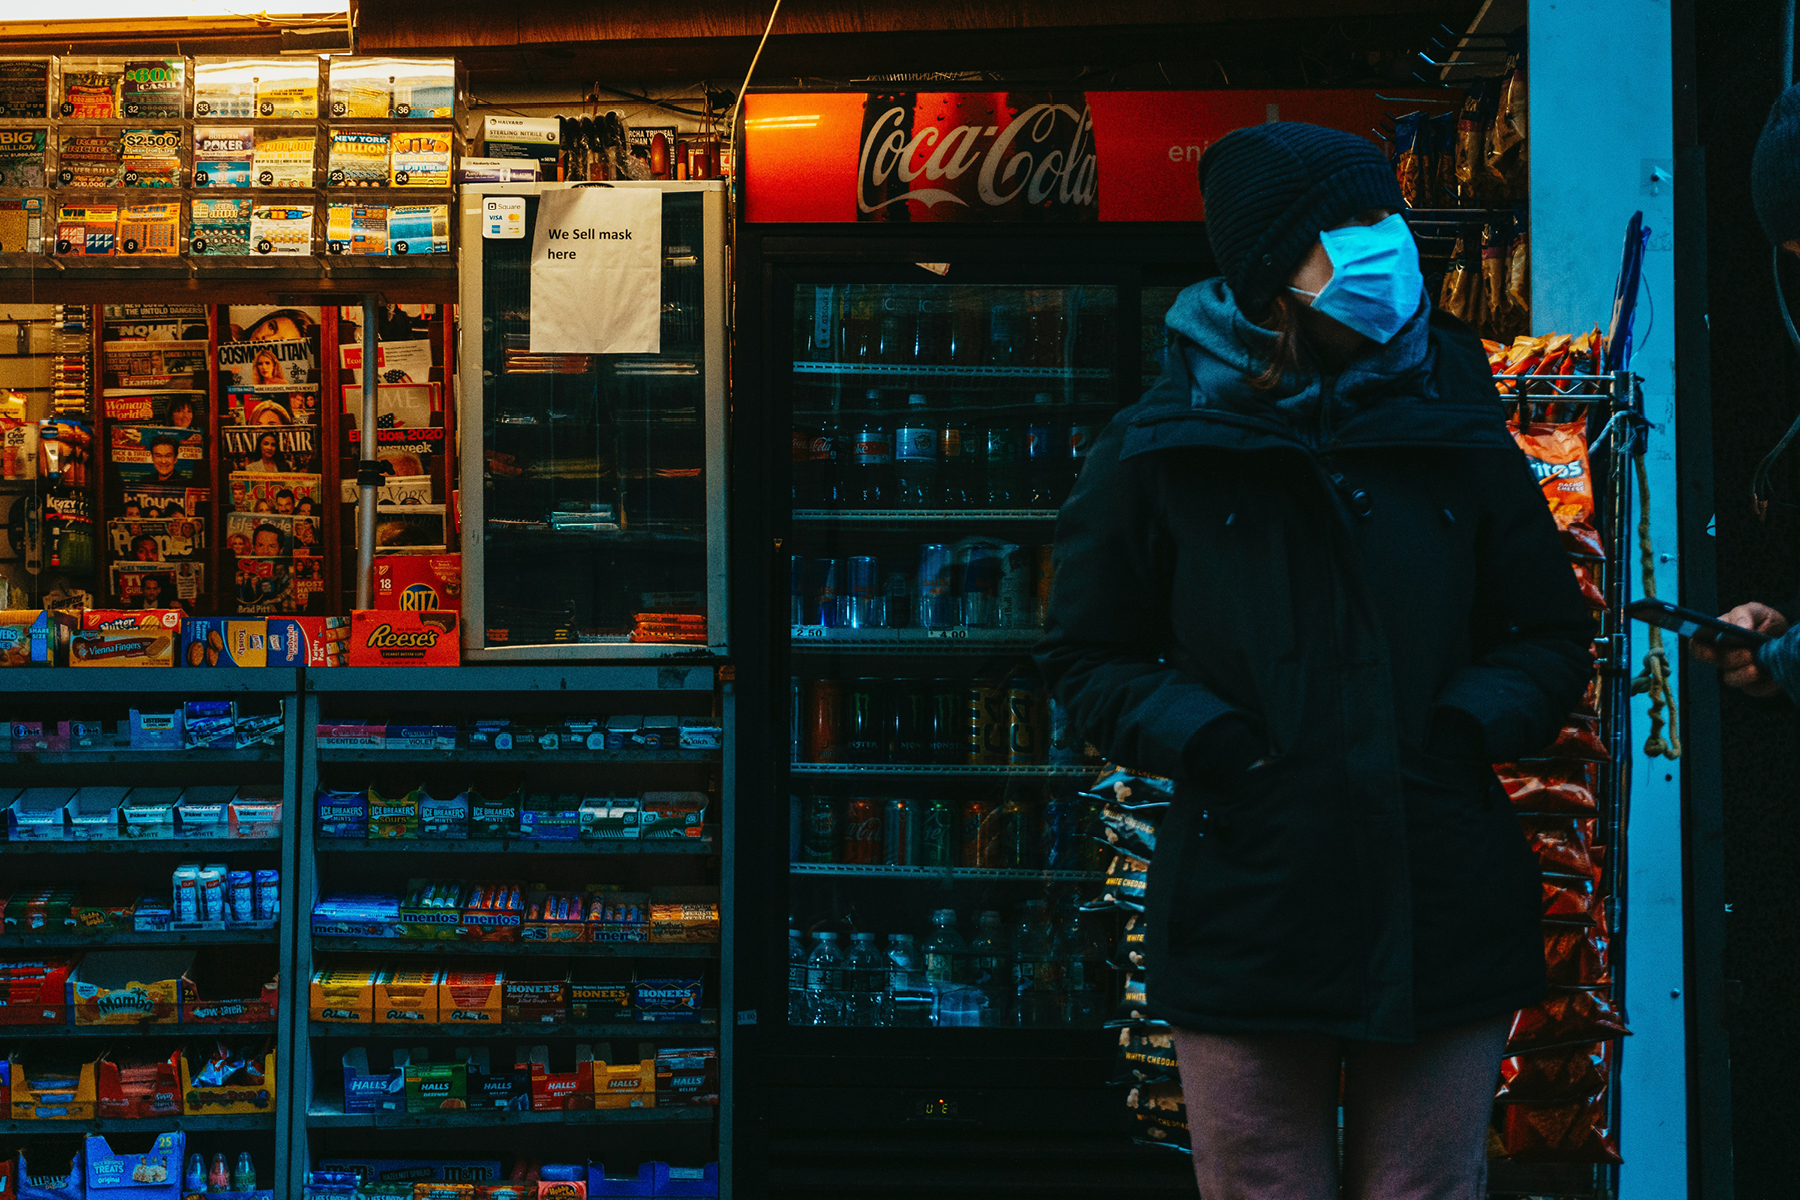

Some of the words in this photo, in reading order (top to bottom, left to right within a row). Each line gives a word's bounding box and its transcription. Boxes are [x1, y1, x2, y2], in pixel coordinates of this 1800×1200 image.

[139, 81, 180, 90] CASH
[63, 105, 72, 113] 31
[127, 105, 139, 114] 32
[197, 103, 209, 112] 33
[261, 103, 272, 113] 34
[333, 103, 345, 112] 35
[397, 106, 409, 114] 36
[0, 132, 33, 144] BIG
[203, 140, 243, 150] POKER
[333, 143, 386, 154] MILLION
[394, 138, 449, 154] WILD
[395, 154, 446, 162] NUMBERS
[857, 102, 1099, 213] Coca-Cola
[62, 173, 72, 181] 19
[126, 173, 138, 181] 20
[196, 173, 207, 181] 21
[260, 173, 272, 182] 22
[331, 171, 343, 180] 23
[396, 172, 408, 182] 24
[497, 202, 521, 211] Square
[62, 208, 86, 218] WIN
[548, 228, 570, 240] We
[572, 228, 596, 240] Sell
[598, 228, 633, 240] mask
[61, 242, 68, 250] 7
[127, 242, 134, 250] 8
[196, 241, 203, 249] 9
[260, 242, 270, 250] 10
[331, 243, 340, 251] 11
[396, 243, 407, 251] 12
[547, 248, 577, 260] here
[140, 307, 168, 315] UNTOLD
[105, 399, 152, 411] Woman's
[106, 409, 140, 419] World
[7, 430, 26, 440] Clear
[348, 429, 404, 442] Eltion
[407, 429, 443, 440] 2020
[278, 431, 313, 452] FAIR
[46, 493, 77, 513] KRAZY
[380, 578, 392, 589] 18
[402, 589, 436, 612] RITZ
[238, 604, 255, 613] Brad
[366, 624, 439, 648] Reese's
[796, 629, 823, 637] 2.50
[939, 630, 967, 638] 4.00
[237, 628, 247, 657] Toasty
[286, 624, 294, 662] Sandwich
[89, 644, 115, 655] Vienna
[114, 642, 142, 652] Fingers
[12, 724, 41, 740] Orbit
[72, 723, 100, 739] Orbit
[320, 805, 331, 816] ICE
[332, 805, 363, 817] BREAKERS
[371, 805, 382, 816] ICE
[383, 805, 414, 817] BREAKERS
[422, 807, 433, 818] ICE
[434, 807, 465, 819] BREAKERS
[473, 806, 484, 817] ICE
[485, 806, 516, 818] BREAKERS
[1105, 876, 1122, 887] WHITE
[1122, 877, 1148, 890] CHEDDA
[402, 912, 458, 924] mentos
[463, 914, 520, 925] mentos
[1126, 933, 1146, 943] WHITE
[507, 984, 560, 993] HONEES
[572, 989, 626, 998] HONEES
[638, 988, 692, 998] HONEES
[1125, 992, 1147, 1002] WHITE
[98, 995, 155, 1014] Mamba
[321, 1008, 361, 1020] Rila
[1125, 1050, 1147, 1062] WHITE
[1147, 1053, 1178, 1067] CHEDDA
[351, 1081, 388, 1090] HALLS
[421, 1082, 450, 1091] HALLS
[483, 1082, 512, 1090] HALLS
[547, 1081, 577, 1090] HALLS
[609, 1079, 638, 1088] HALLS
[672, 1077, 702, 1086] HALLS
[159, 1136, 172, 1148] 25
[94, 1165, 124, 1175] TREATS
[409, 1168, 431, 1178] SPREAD
[97, 1176, 120, 1185] original
